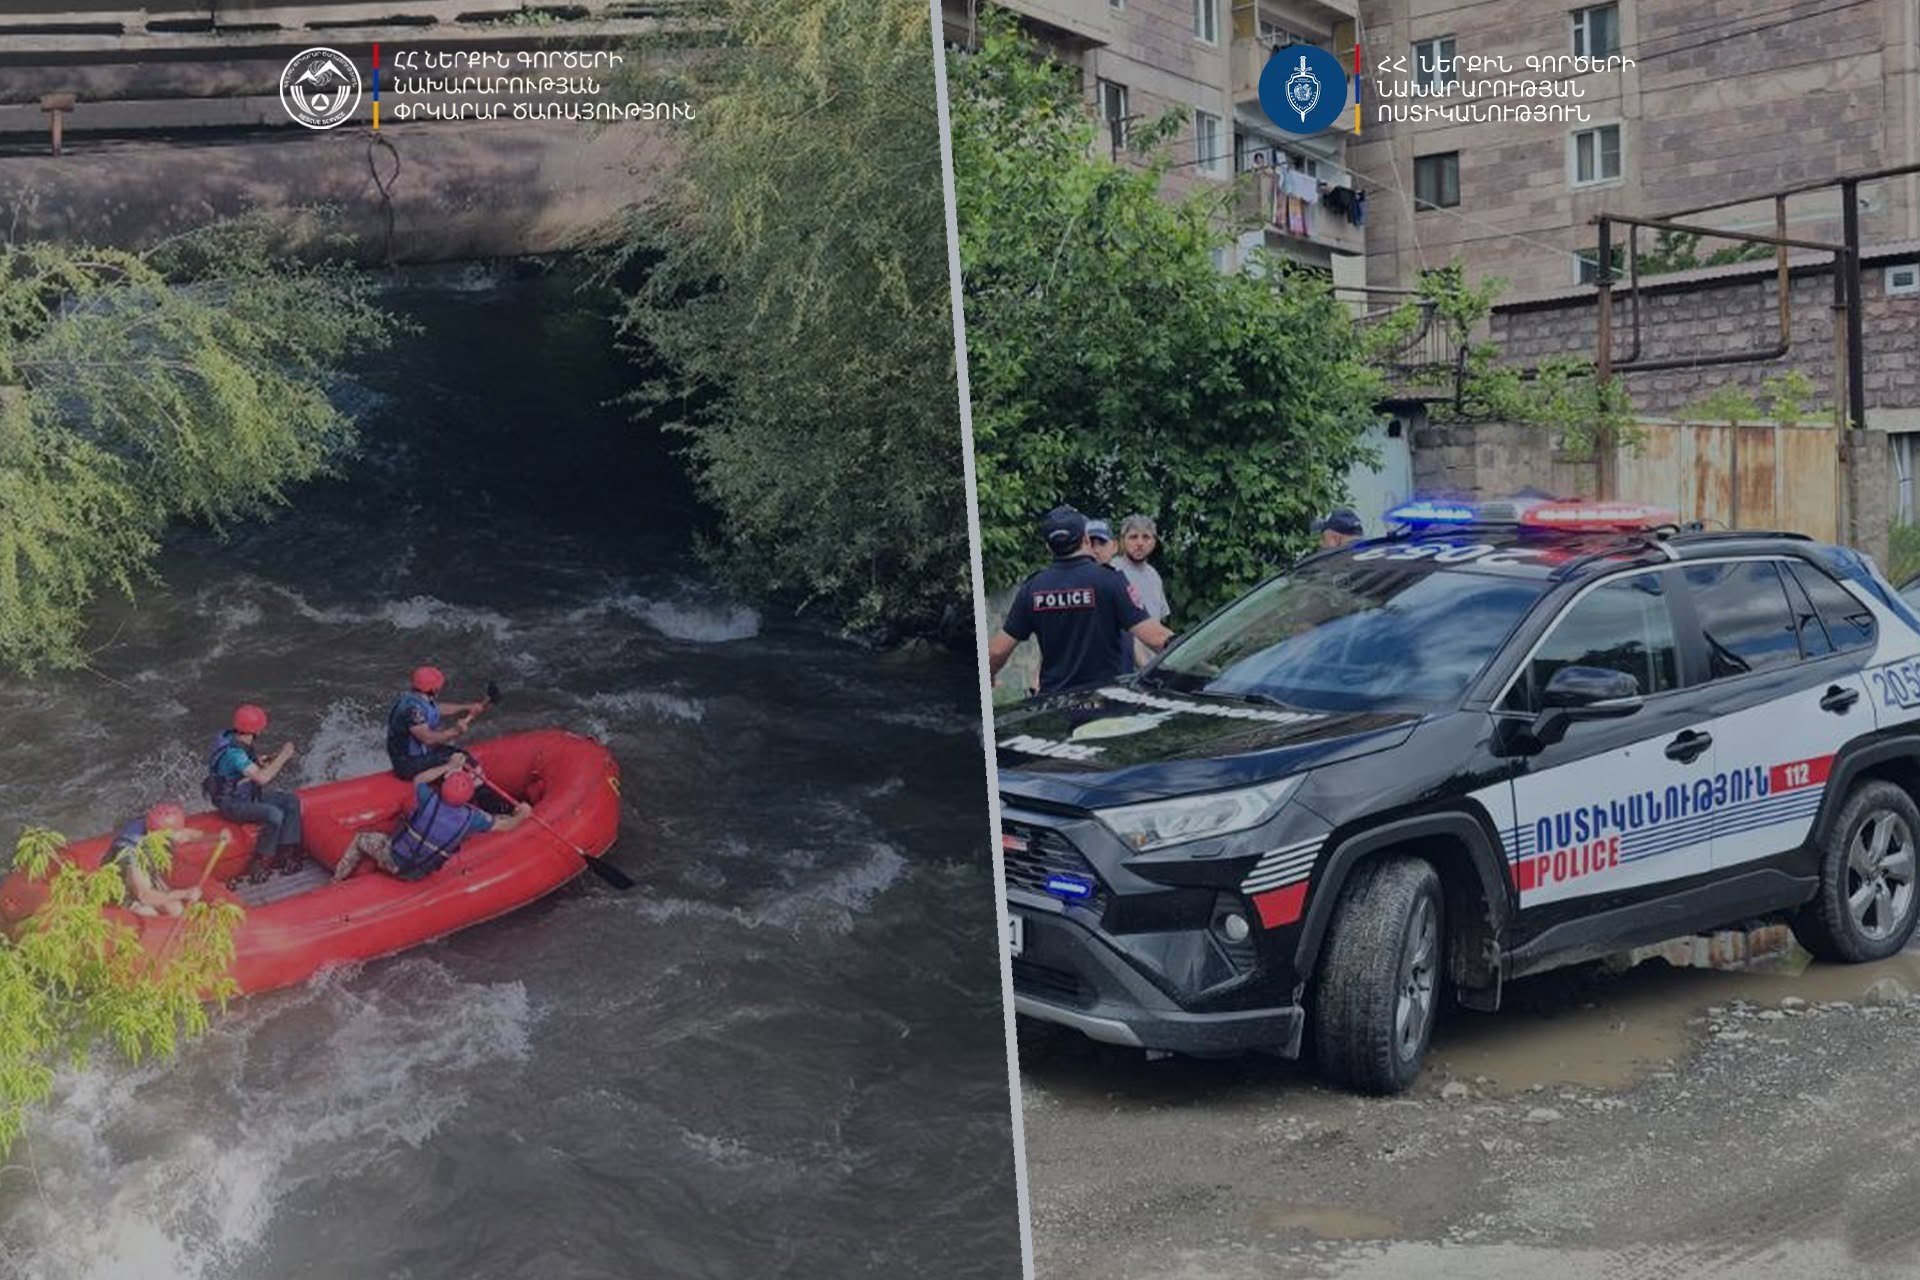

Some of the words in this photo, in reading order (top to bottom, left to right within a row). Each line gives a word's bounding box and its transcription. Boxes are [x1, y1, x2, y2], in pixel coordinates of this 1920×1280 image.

[1035, 591, 1092, 609] POLICE
[1785, 763, 1811, 787] 112
[1536, 765, 1769, 853] ՈՍՏԻԿԱՆՈՒԹՅՈՒՆ
[1536, 837, 1621, 887] POLICE
